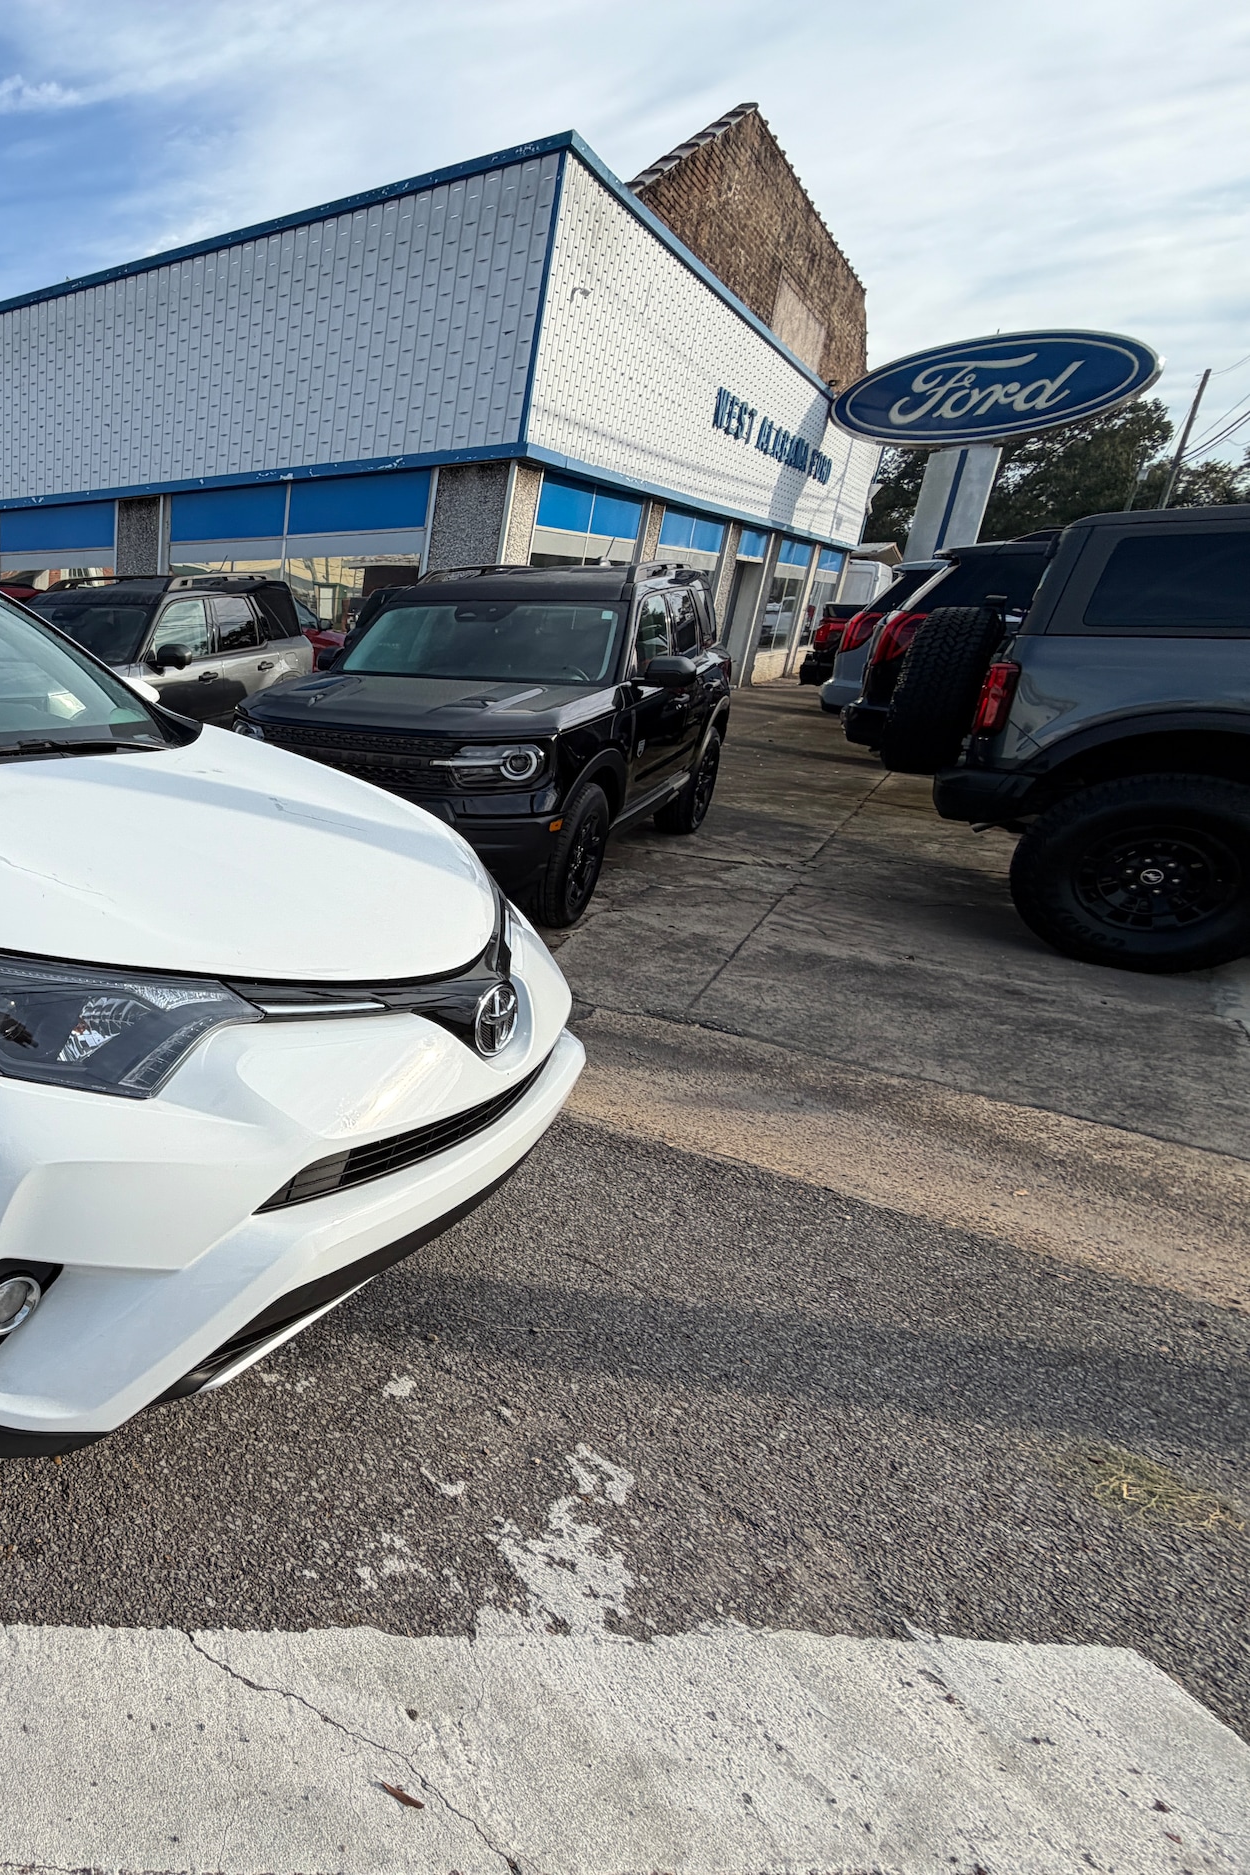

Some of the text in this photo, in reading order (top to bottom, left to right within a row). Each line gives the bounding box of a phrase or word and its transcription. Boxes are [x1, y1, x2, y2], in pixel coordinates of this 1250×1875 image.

[888, 352, 1087, 425] Ford
[713, 387, 758, 444] WEST
[755, 416, 810, 472] ALABAMA
